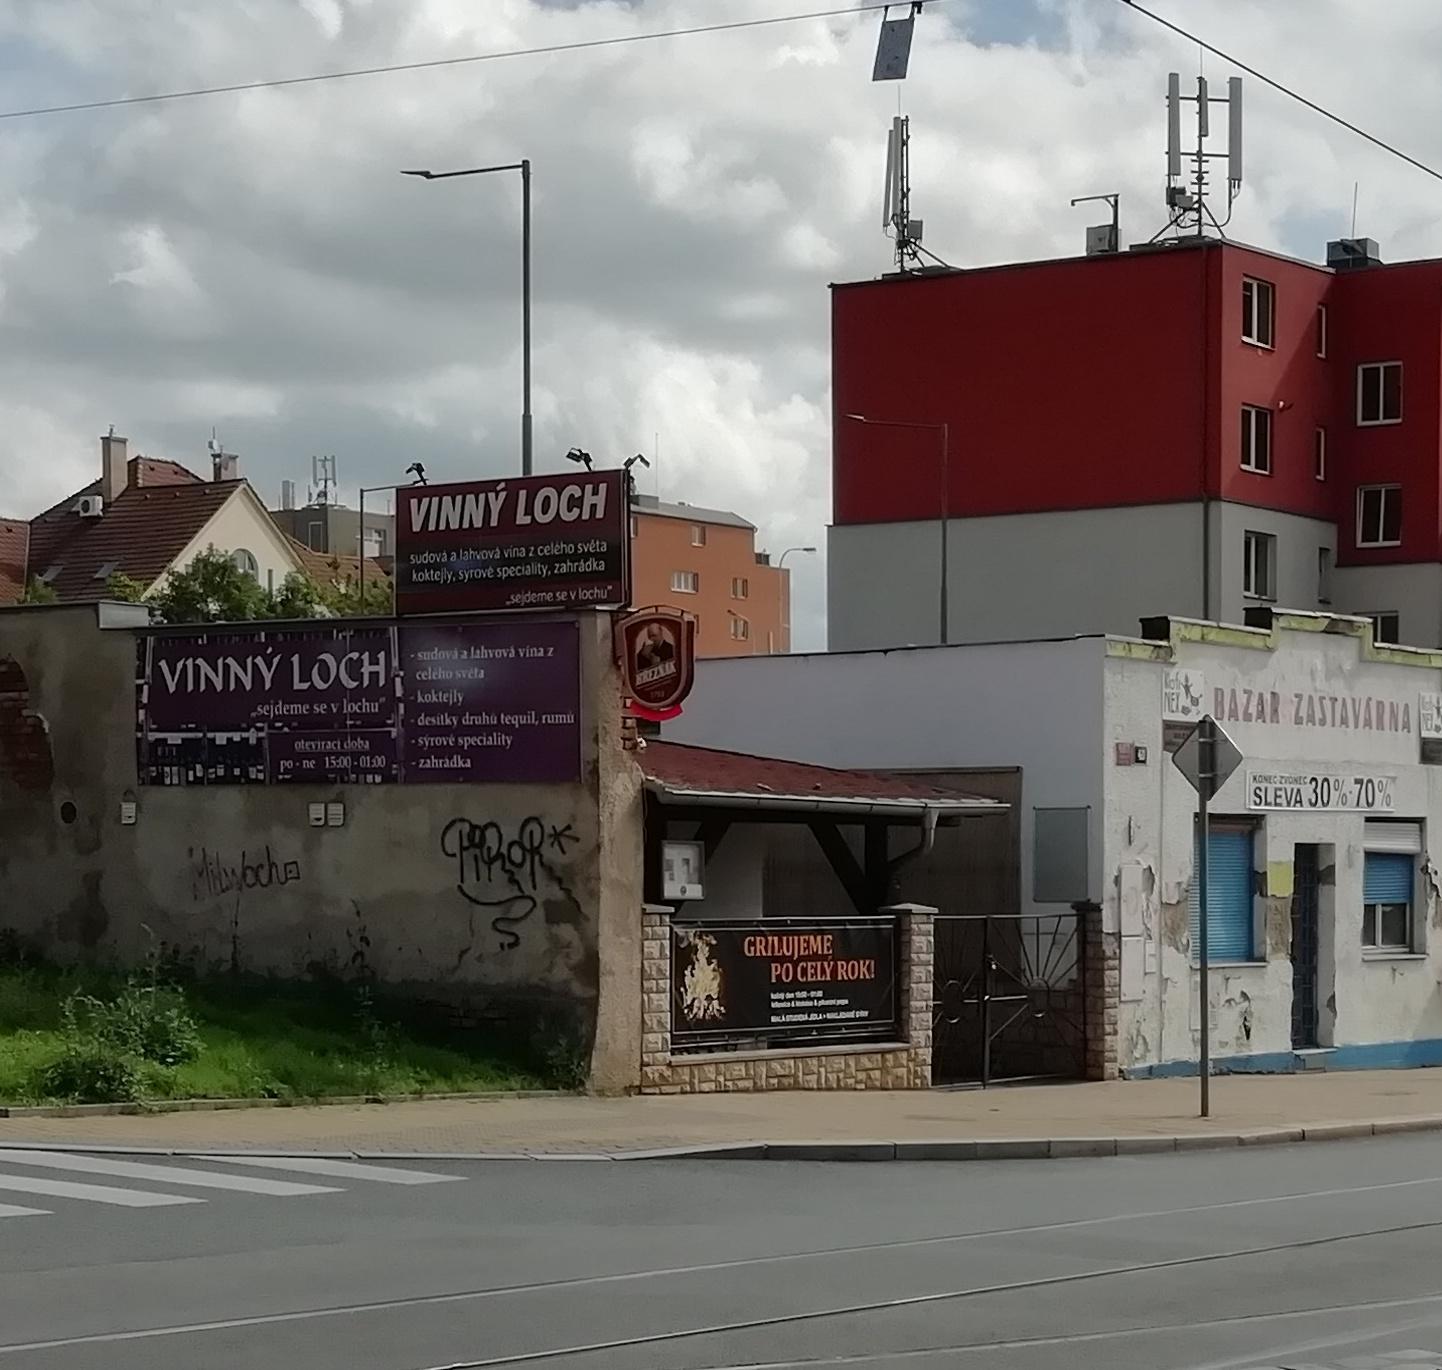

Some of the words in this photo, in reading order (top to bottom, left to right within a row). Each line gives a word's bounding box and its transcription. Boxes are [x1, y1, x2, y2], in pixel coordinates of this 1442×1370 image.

[409, 482, 508, 533] VINNÝ
[515, 482, 608, 526] LOCH
[410, 550, 447, 565] sudová
[449, 552, 457, 562] a
[459, 547, 500, 561] lahvová
[504, 546, 526, 558] vína
[528, 548, 535, 557] z
[537, 542, 574, 556] celého
[577, 539, 607, 553] světa
[412, 568, 456, 584] koktejly,
[458, 566, 494, 581] sýrové
[496, 562, 551, 580] speciality,
[553, 558, 605, 574] zahrádka
[556, 592, 568, 601] se
[569, 591, 577, 600] v
[417, 647, 458, 661] sudová
[460, 650, 468, 660] a
[470, 645, 515, 659] lahvová
[518, 644, 544, 658] vína
[547, 647, 554, 657] z
[158, 646, 282, 694] VINNÝ
[290, 650, 386, 691] LOCH
[416, 666, 453, 681] celého
[455, 667, 485, 679] světa
[417, 689, 465, 706] koktejly
[313, 703, 327, 714] se
[330, 703, 339, 713] v
[1214, 687, 1280, 724] BAZAR
[1293, 692, 1411, 734] ZASTAVÁRNA
[417, 712, 458, 728] desítky
[501, 711, 539, 728] tequil,
[344, 736, 370, 750] doba
[417, 733, 455, 750] sýrové
[457, 732, 513, 749] speciality
[280, 759, 293, 773] po
[302, 758, 316, 769] ne
[324, 756, 351, 769] 15:00
[359, 755, 386, 768] 01:00
[418, 754, 472, 769] zahrádka
[1253, 786, 1304, 808] SLEVA
[744, 934, 833, 961] GRILUJEME
[770, 962, 793, 983] PO
[797, 956, 834, 982] CELÝ
[837, 960, 875, 980] ROK!
